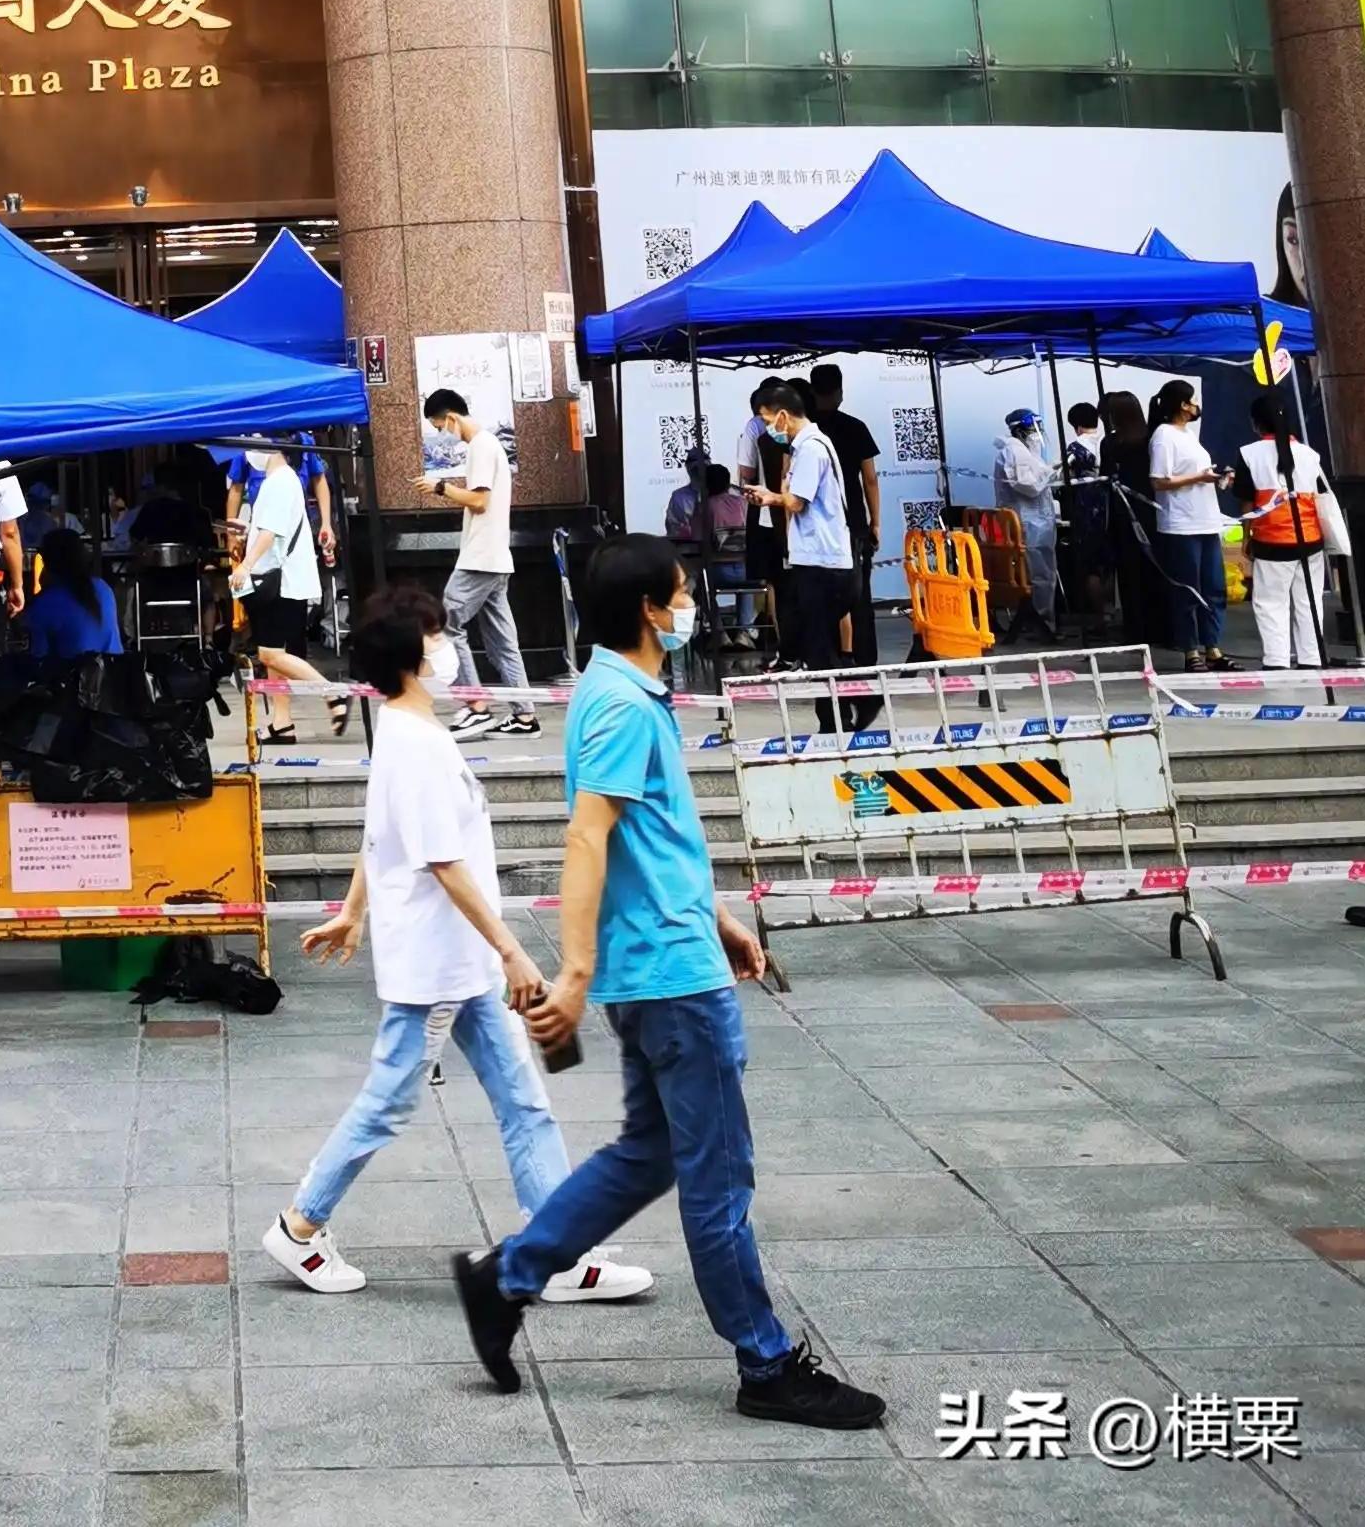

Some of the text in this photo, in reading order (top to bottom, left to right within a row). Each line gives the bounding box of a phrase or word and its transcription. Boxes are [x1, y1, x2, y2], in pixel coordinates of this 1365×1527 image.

[87, 56, 222, 93] Plaza
[675, 168, 866, 187] 广州迪澳迪澳服饰有限公
